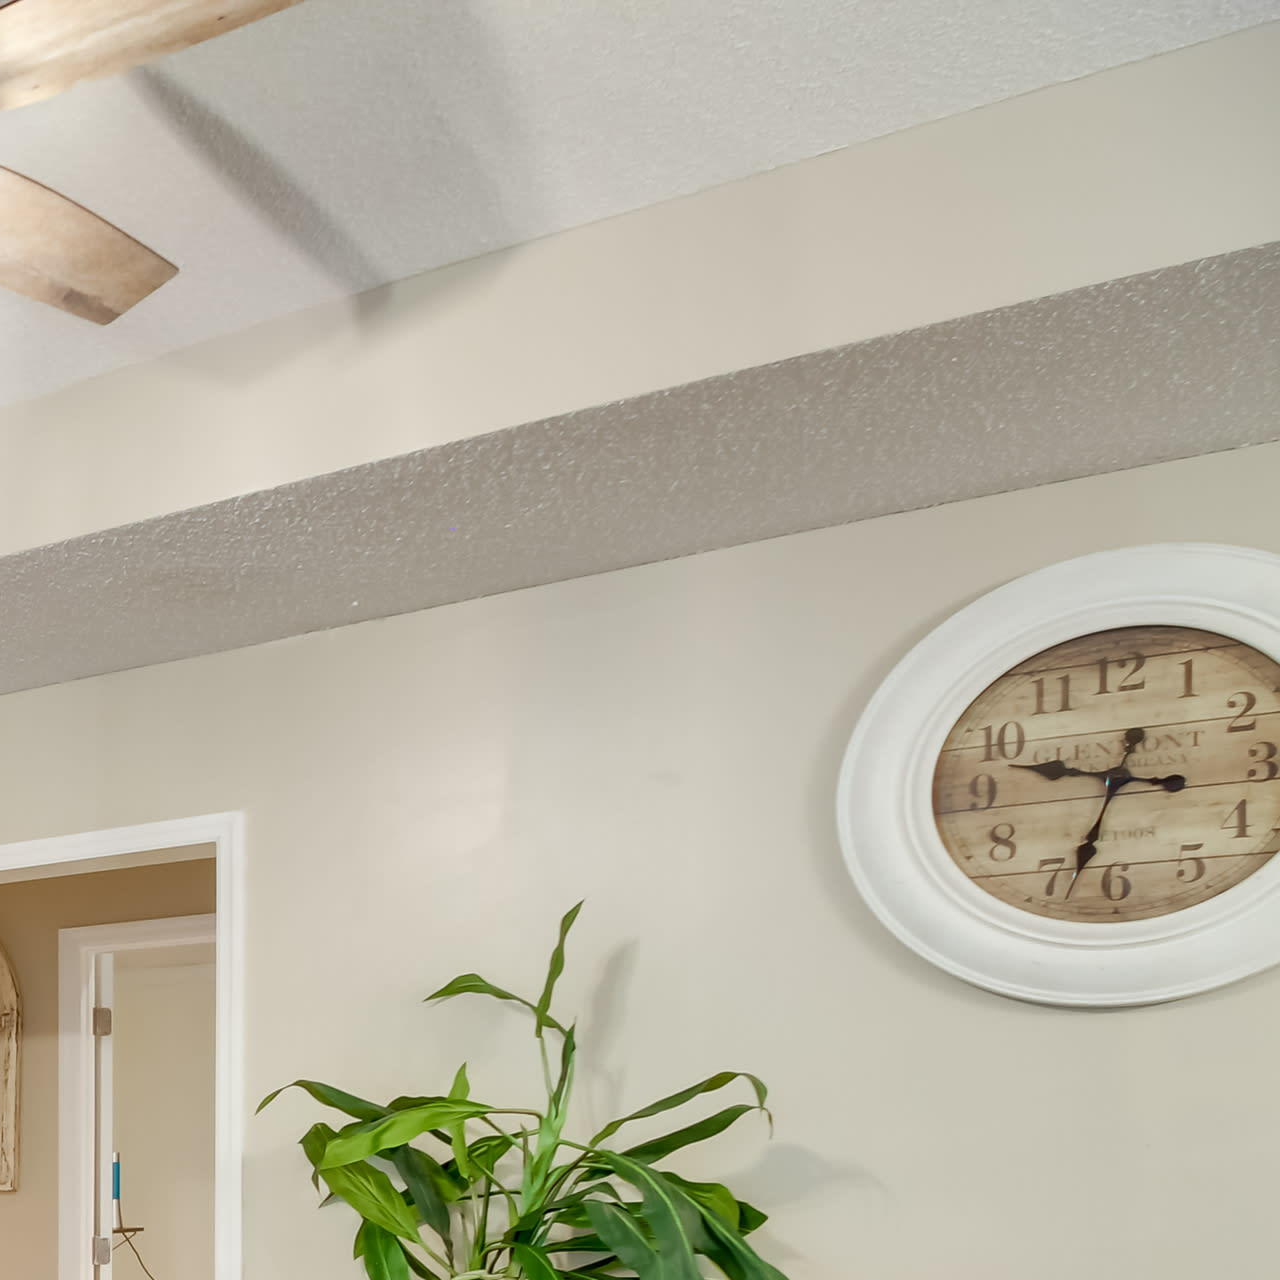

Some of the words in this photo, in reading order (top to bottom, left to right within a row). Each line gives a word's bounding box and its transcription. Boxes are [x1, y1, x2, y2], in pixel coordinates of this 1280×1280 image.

[1093, 651, 1146, 695] 12
[1177, 658, 1200, 698] 1
[1031, 674, 1076, 716] 11
[1226, 691, 1256, 733] 2
[979, 721, 1025, 762] 10
[1033, 731, 1205, 763] GLENONT
[1247, 741, 1279, 782] 3
[969, 773, 998, 810] 9
[1220, 799, 1253, 839] 4
[989, 823, 1016, 862] 8
[1038, 857, 1065, 897] 7
[1101, 862, 1132, 902] 6
[1176, 843, 1205, 883] 5
